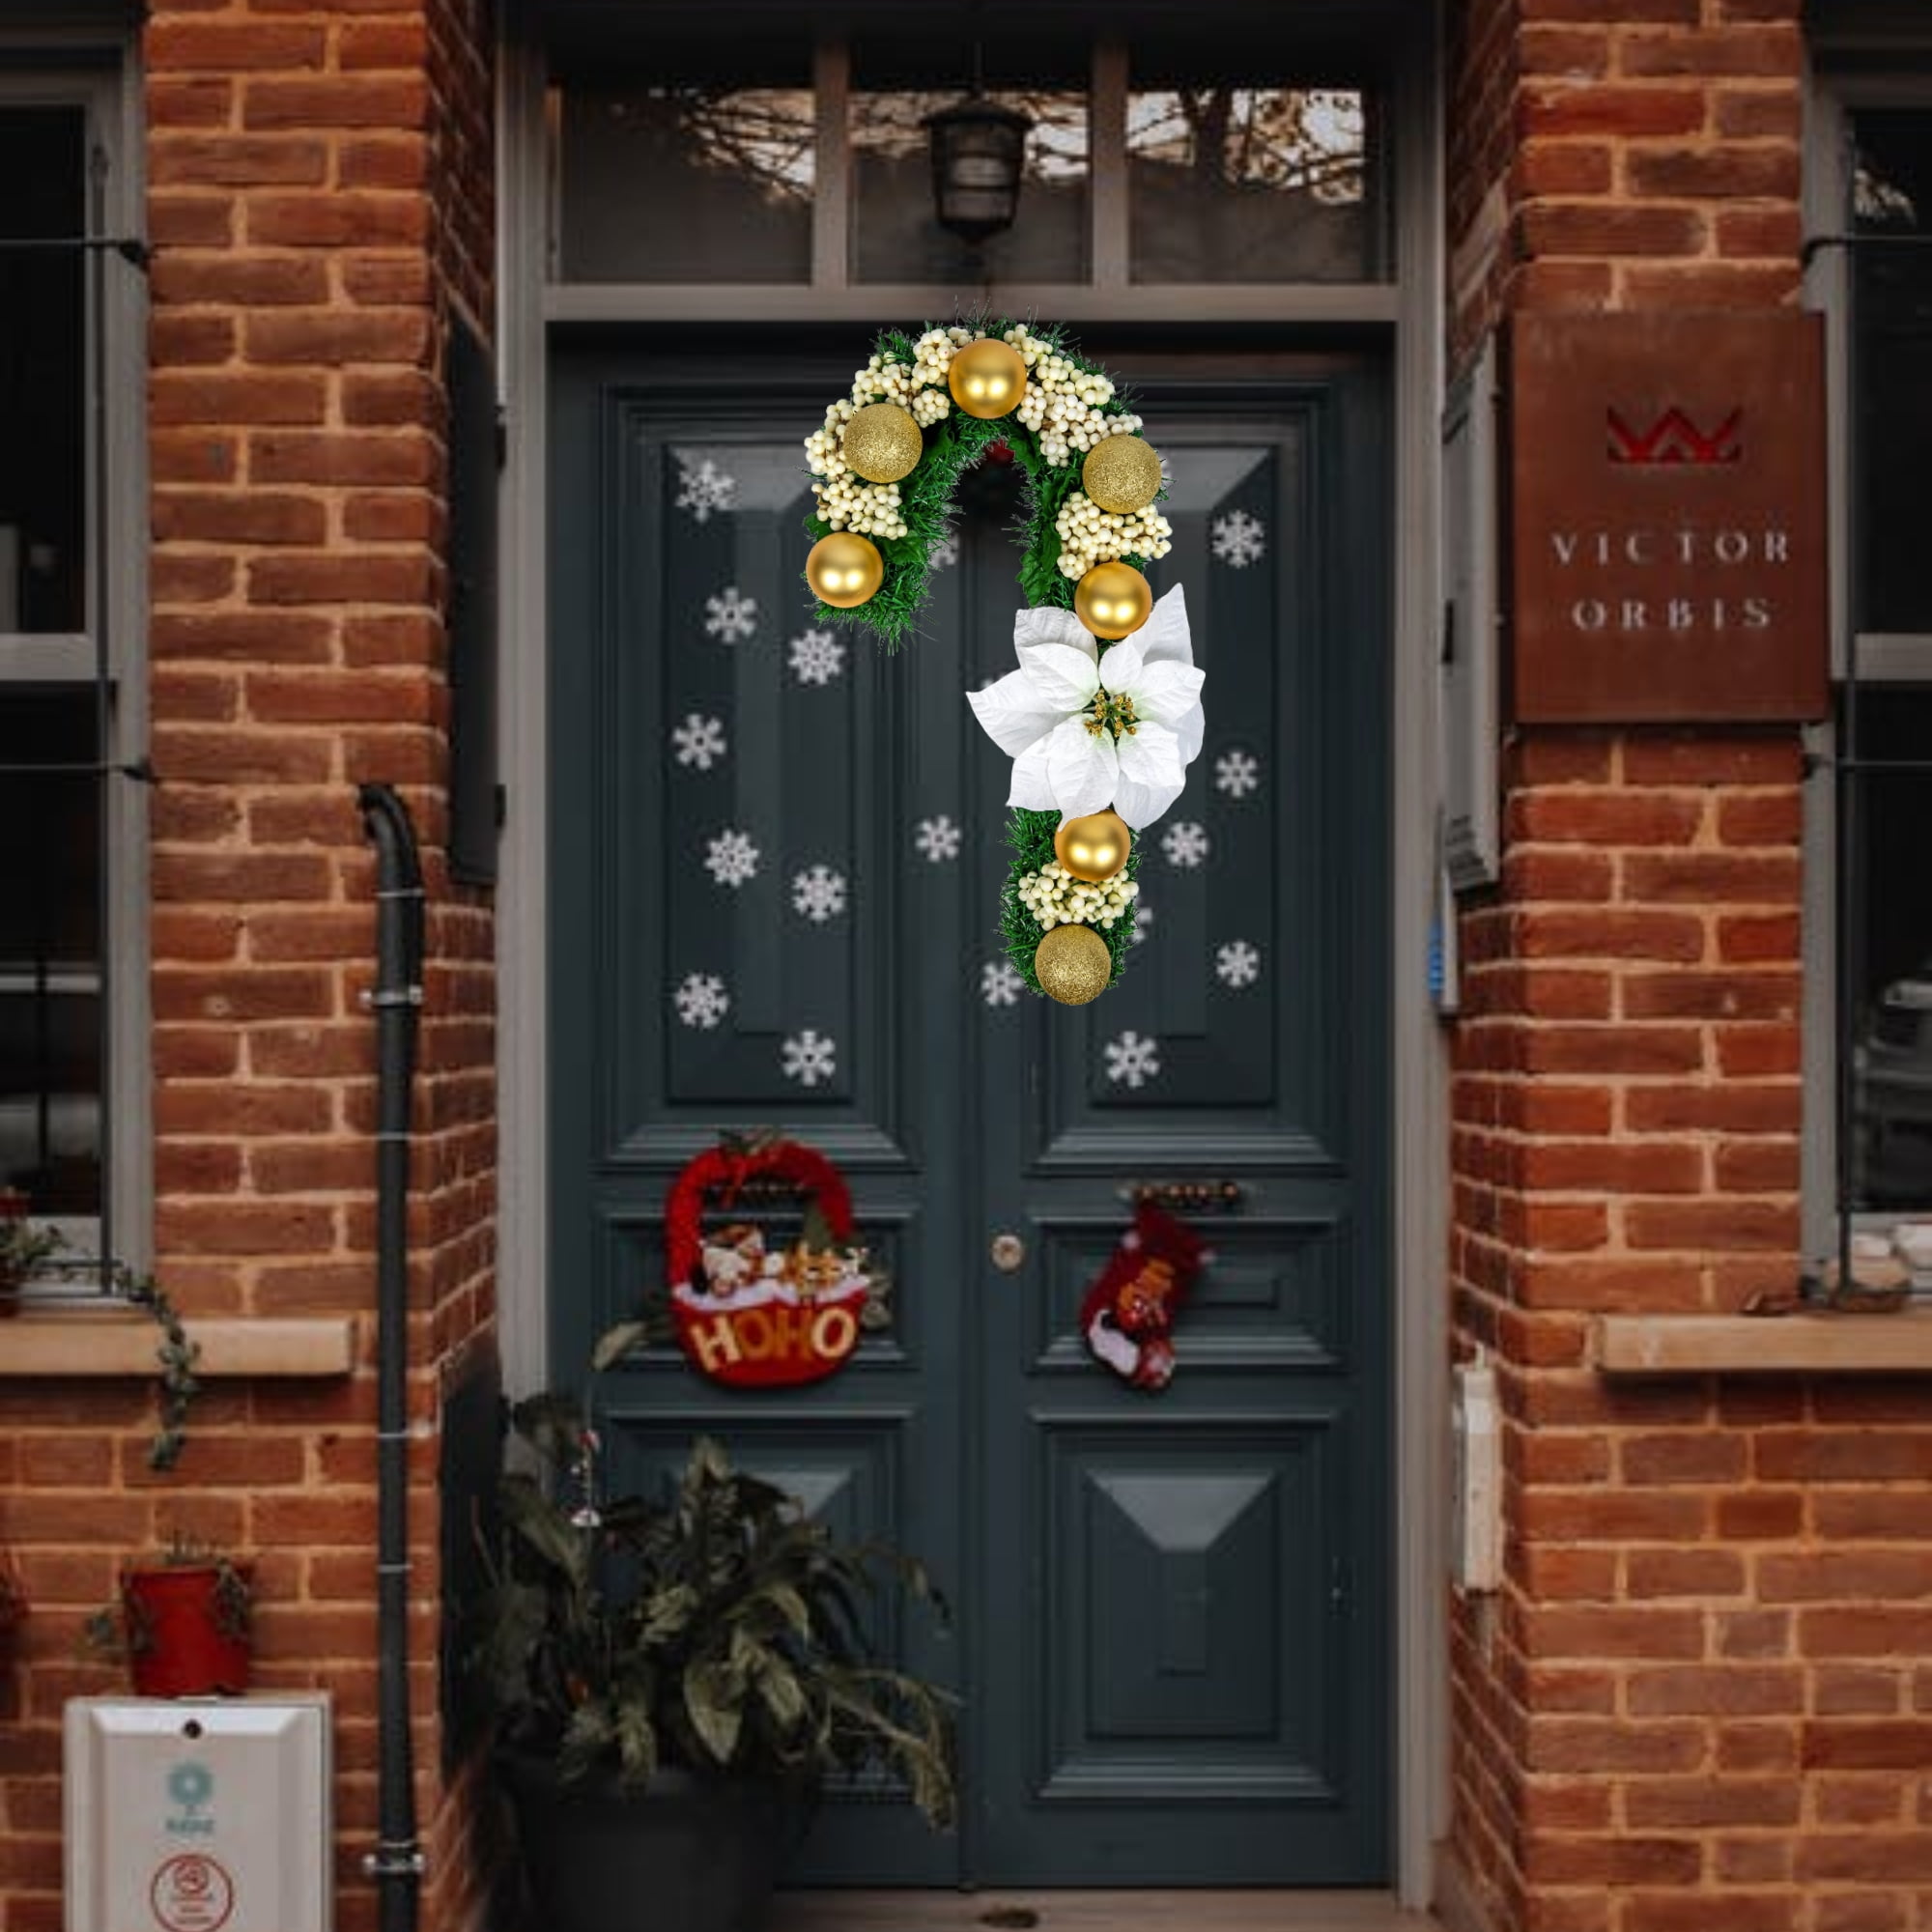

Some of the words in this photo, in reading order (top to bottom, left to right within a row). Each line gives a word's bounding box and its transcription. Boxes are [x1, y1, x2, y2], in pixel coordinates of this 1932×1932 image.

[1551, 531, 1790, 564] VICTOR
[1572, 597, 1771, 630] ORBIS
[690, 1307, 857, 1373] HOHO
